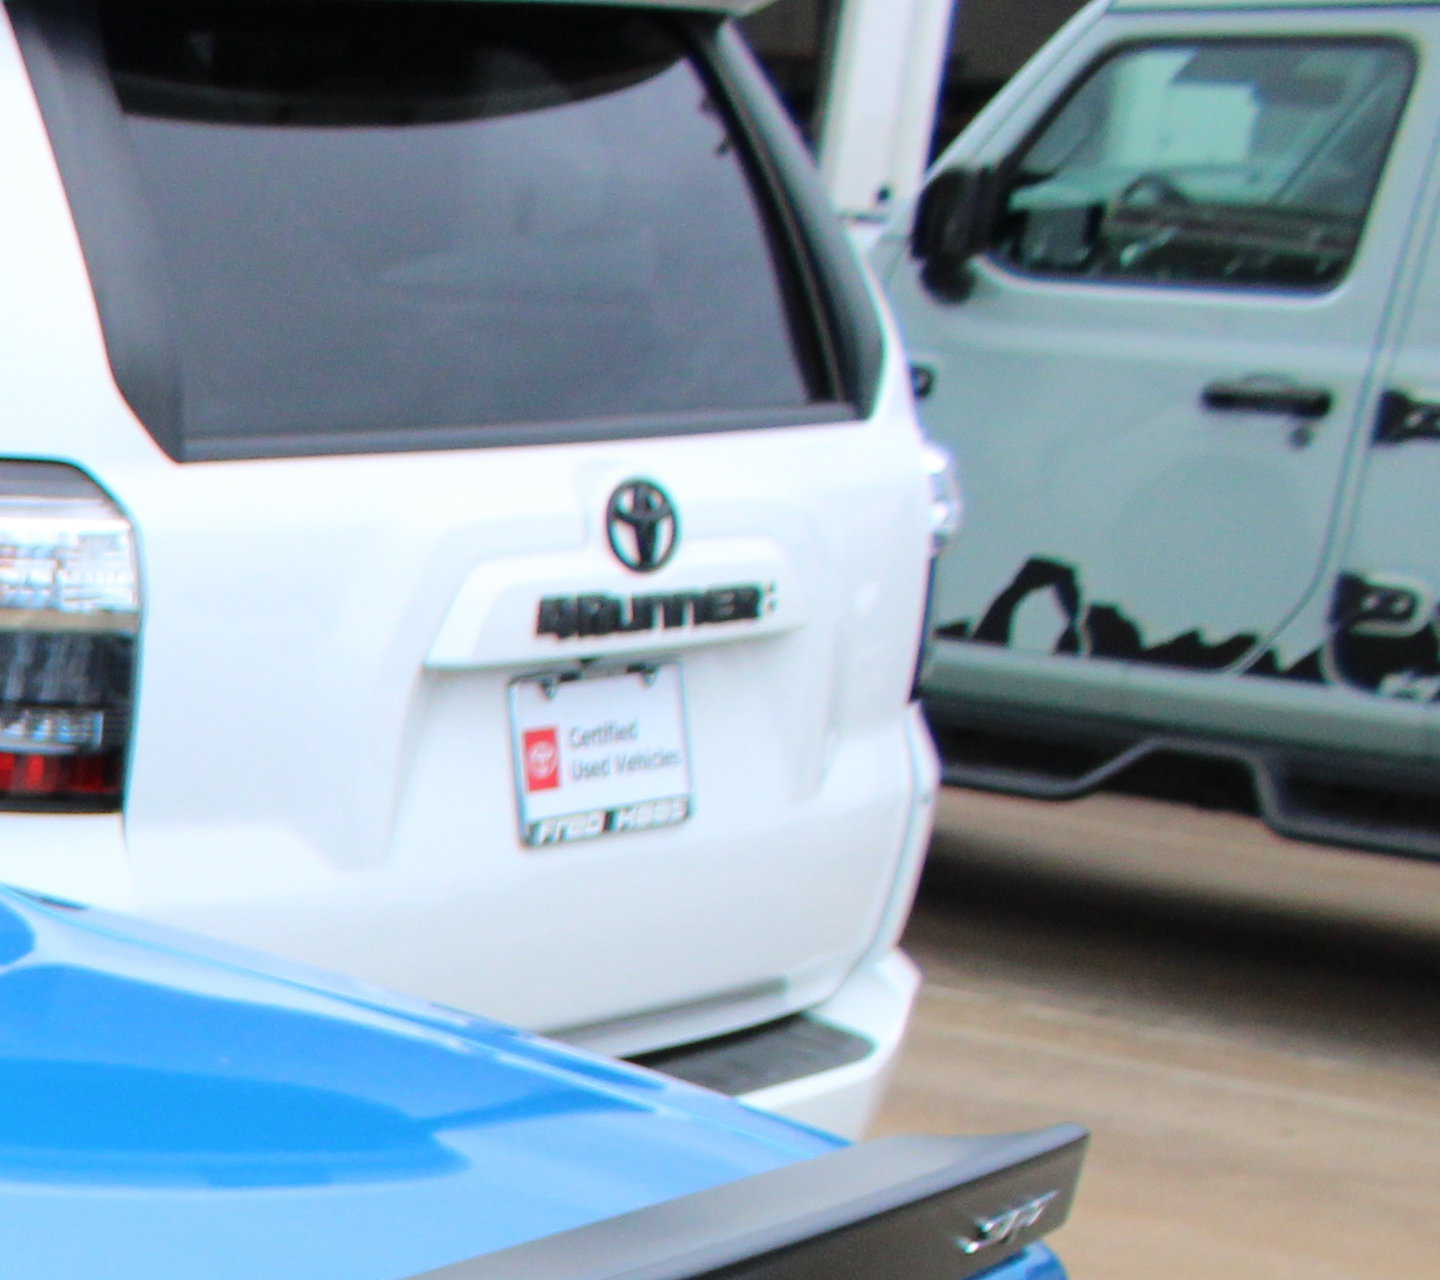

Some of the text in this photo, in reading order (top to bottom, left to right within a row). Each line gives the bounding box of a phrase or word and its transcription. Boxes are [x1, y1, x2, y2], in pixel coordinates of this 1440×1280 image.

[569, 718, 638, 747] Certified
[572, 748, 680, 780] Used Vehicles
